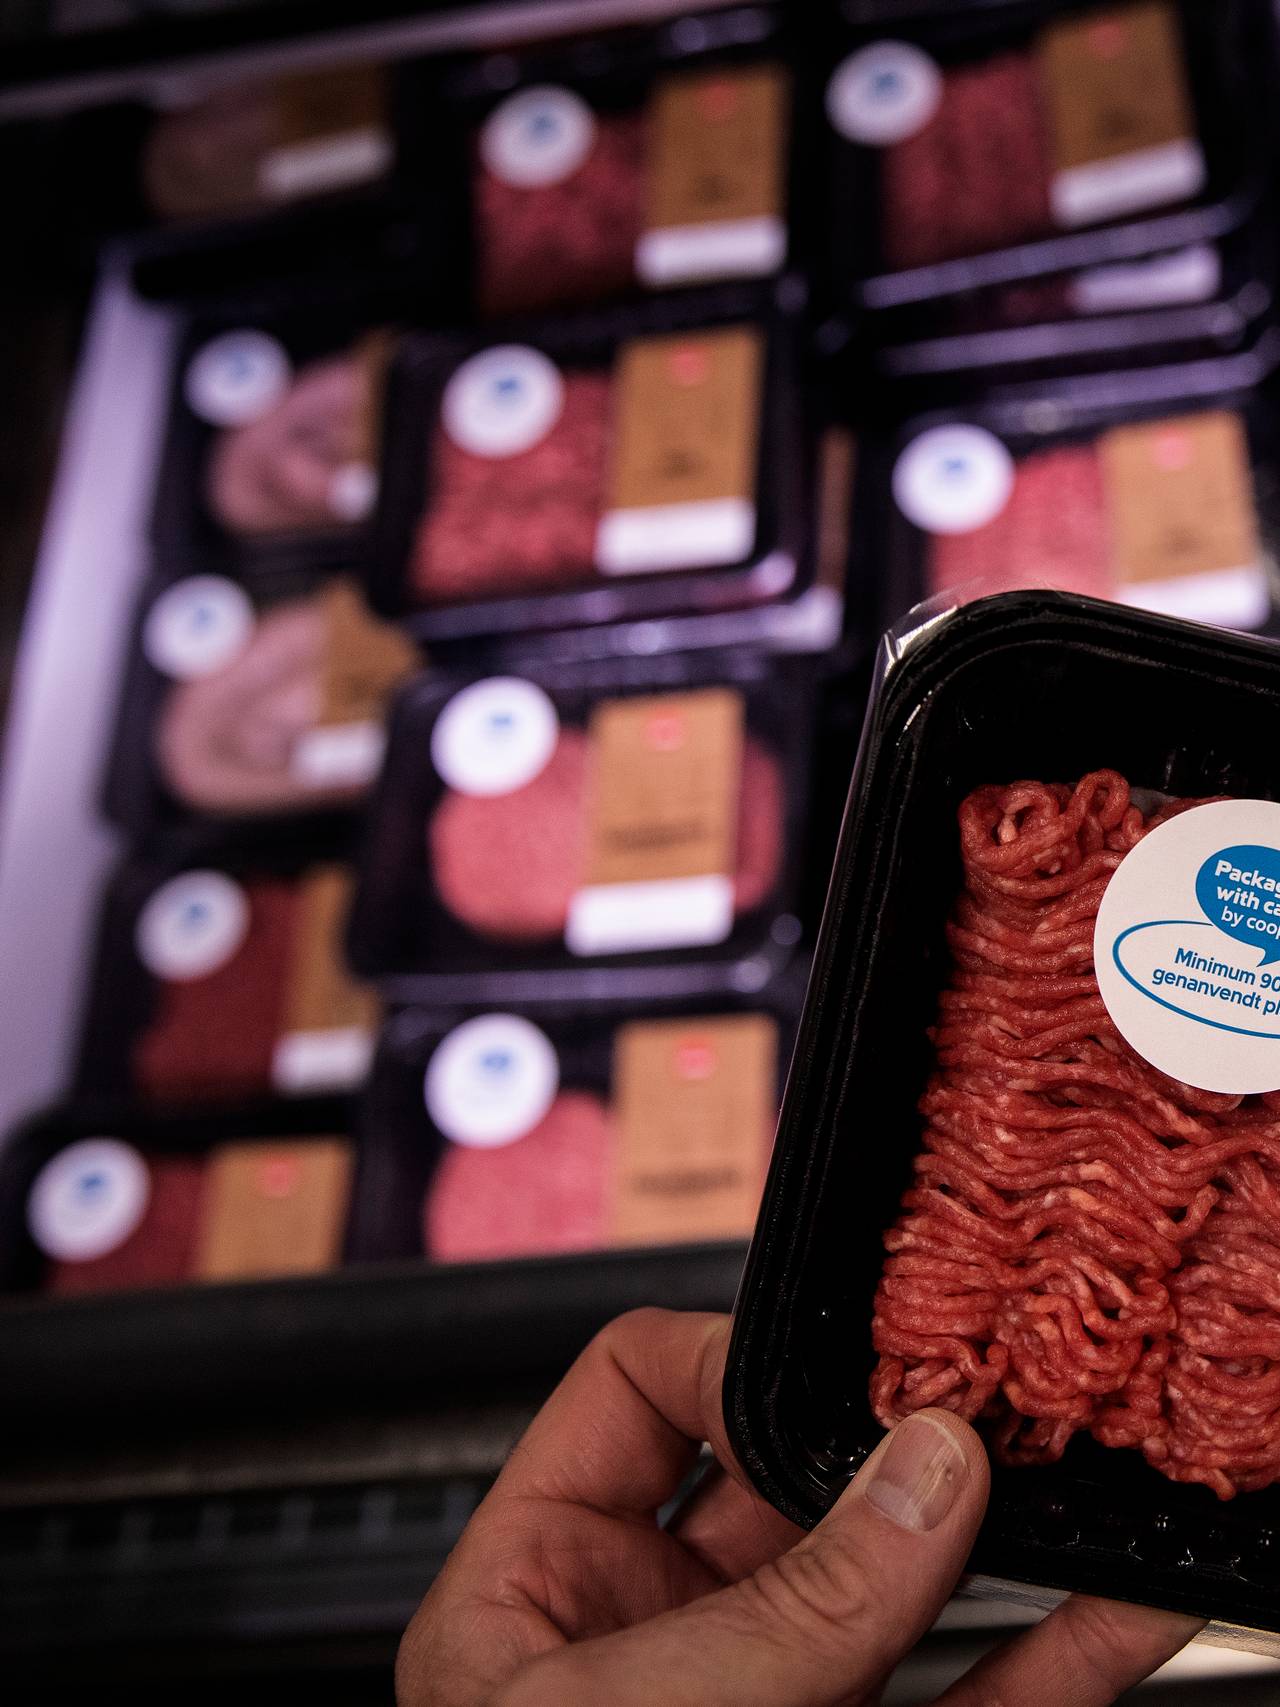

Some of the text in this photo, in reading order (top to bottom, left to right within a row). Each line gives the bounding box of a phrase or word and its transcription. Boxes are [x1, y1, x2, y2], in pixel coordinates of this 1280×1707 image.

[1216, 884, 1260, 911] with
[1221, 906, 1245, 928] by
[1174, 947, 1256, 985] Minimum
[1152, 967, 1262, 1010] genanvendt
